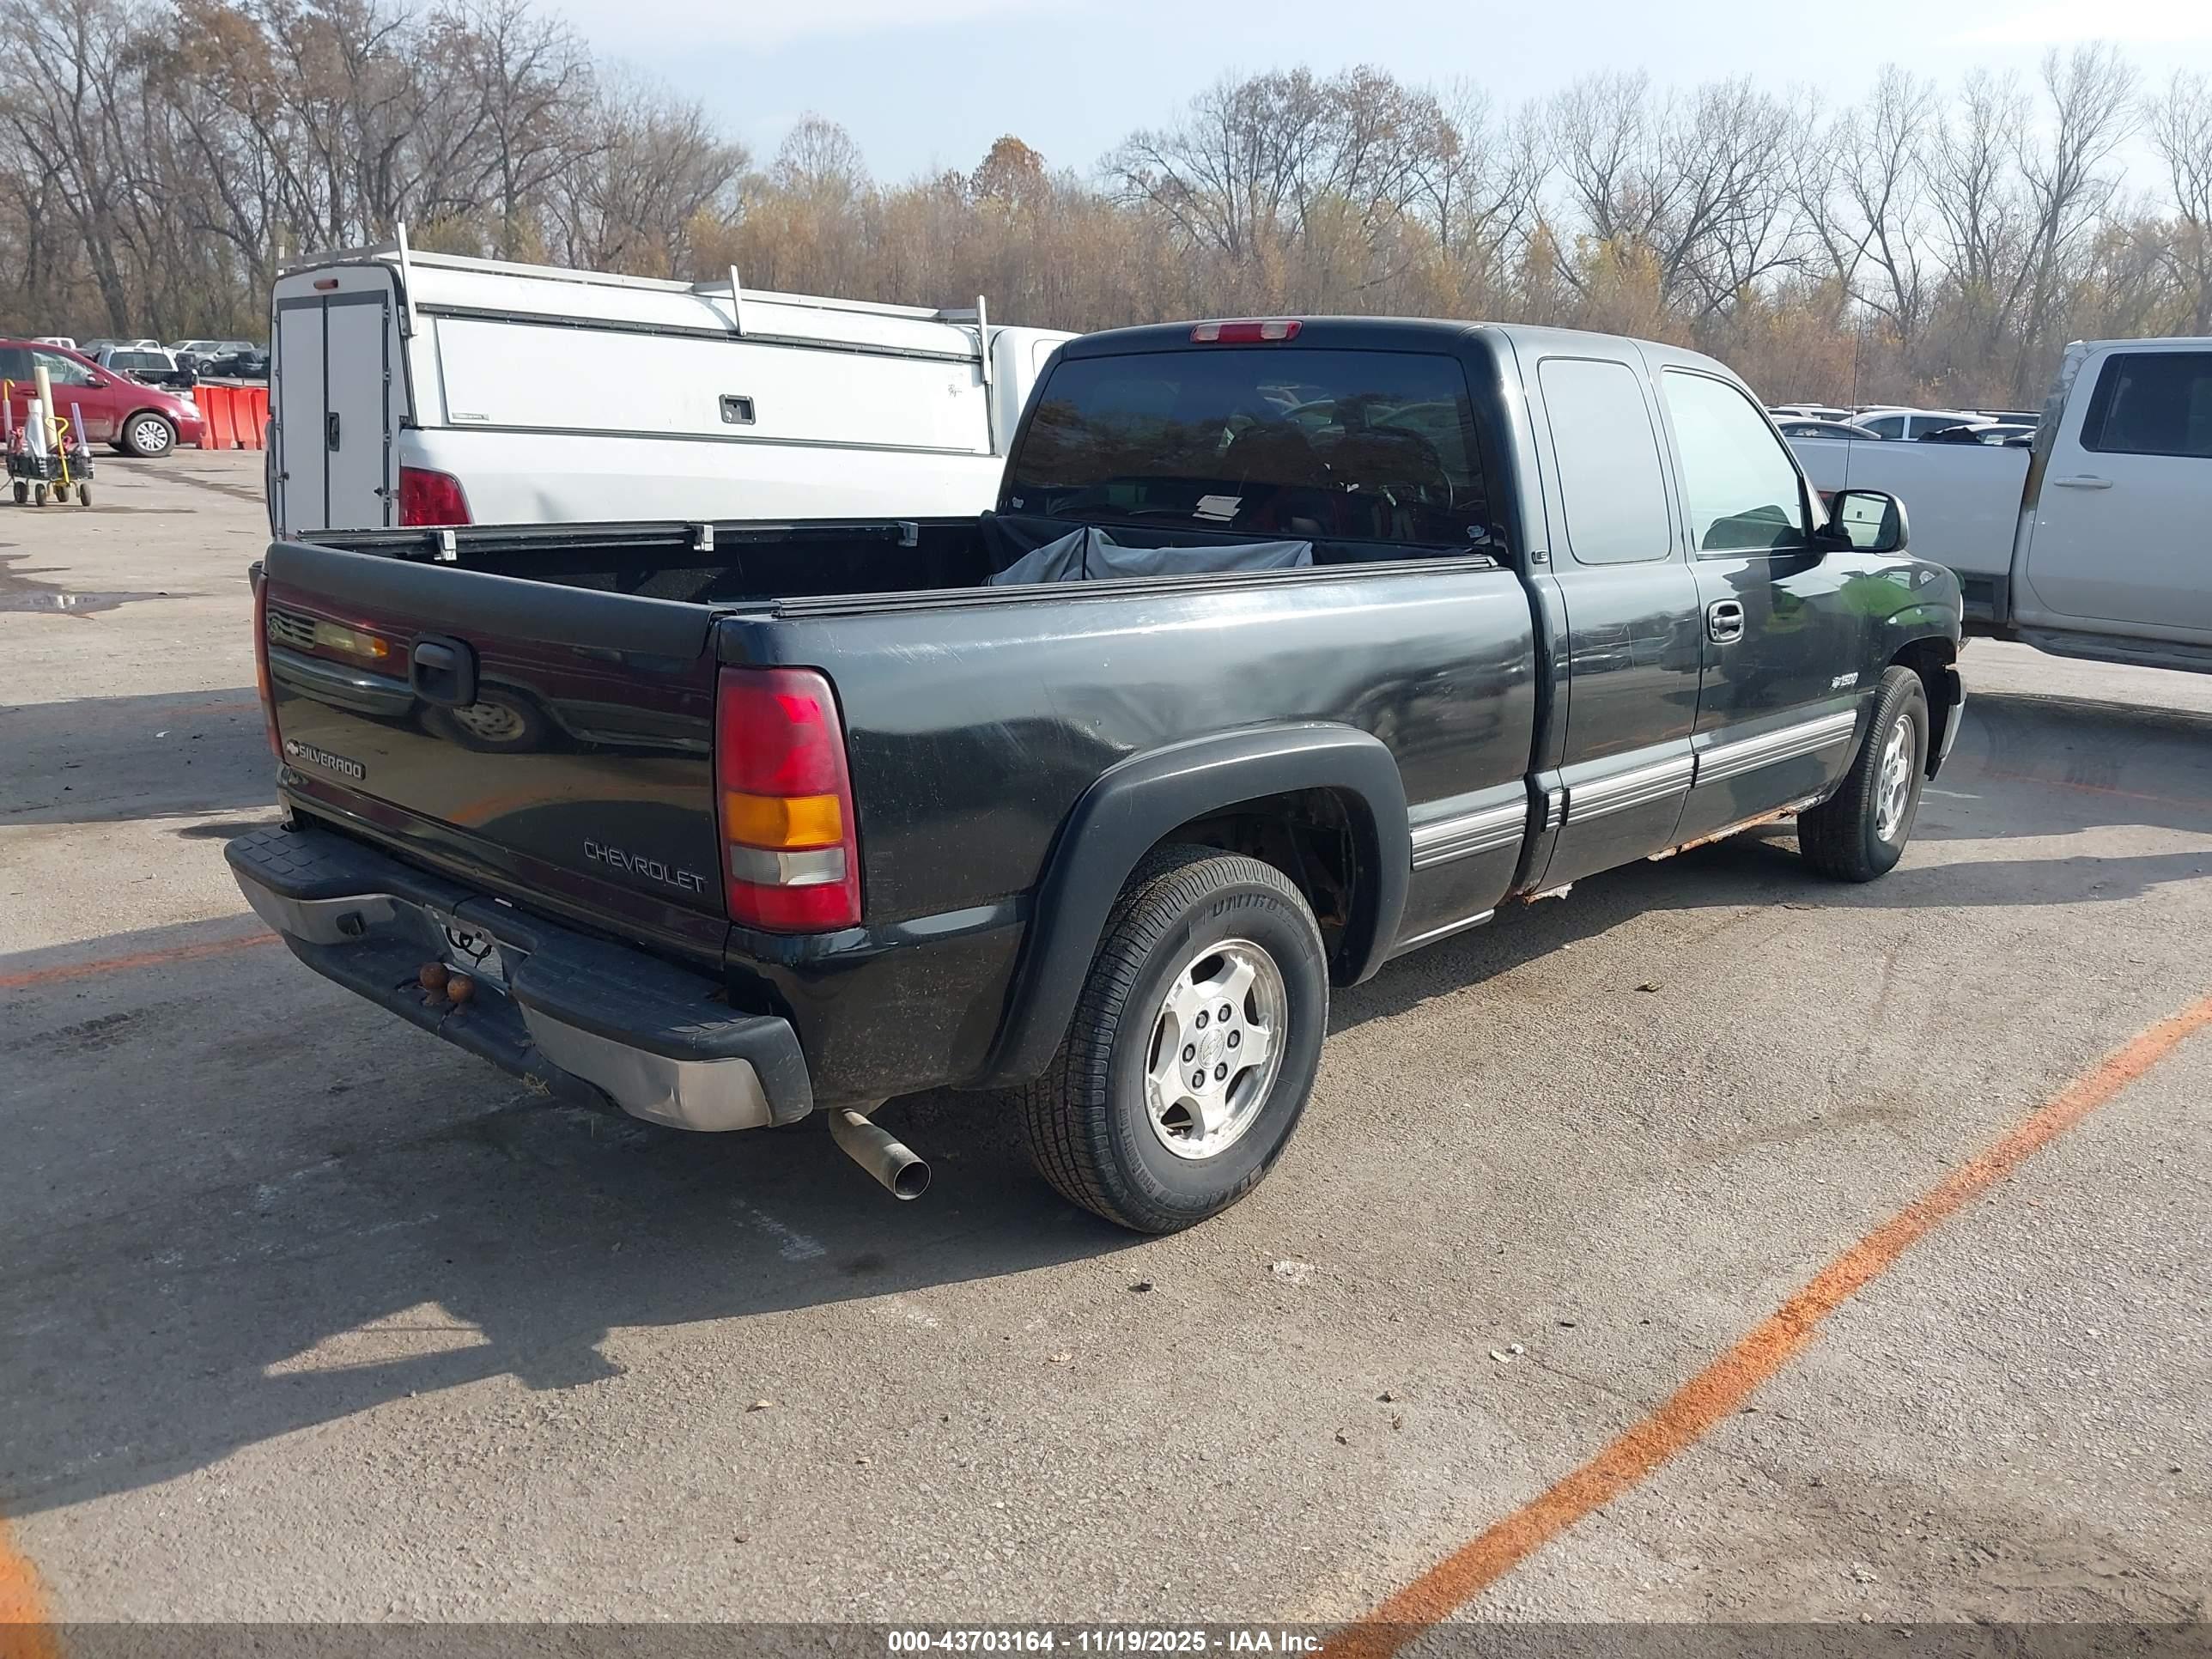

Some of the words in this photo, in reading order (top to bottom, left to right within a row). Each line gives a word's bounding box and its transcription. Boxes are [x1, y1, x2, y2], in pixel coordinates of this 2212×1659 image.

[1840, 672, 1859, 687] 1500
[299, 744, 362, 778] SILVERADO
[584, 841, 704, 893] CHEVROLET
